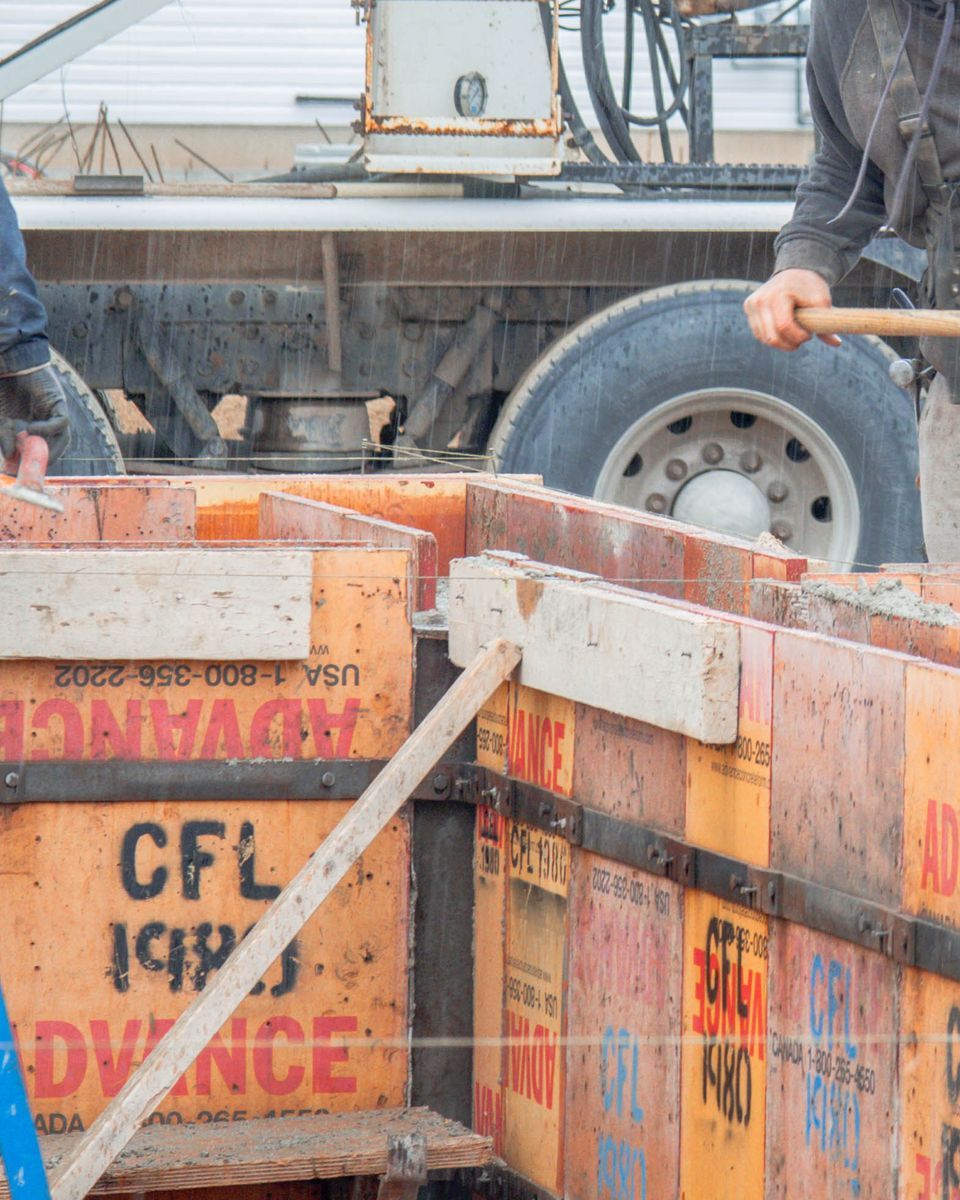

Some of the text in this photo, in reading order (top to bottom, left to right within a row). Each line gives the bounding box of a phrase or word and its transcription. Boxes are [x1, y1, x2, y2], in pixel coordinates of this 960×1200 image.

[55, 663, 360, 688] 1-800-356-2202 USA
[122, 821, 282, 901] CFL
[810, 953, 858, 1061] CFL
[602, 1024, 645, 1124] CFL
